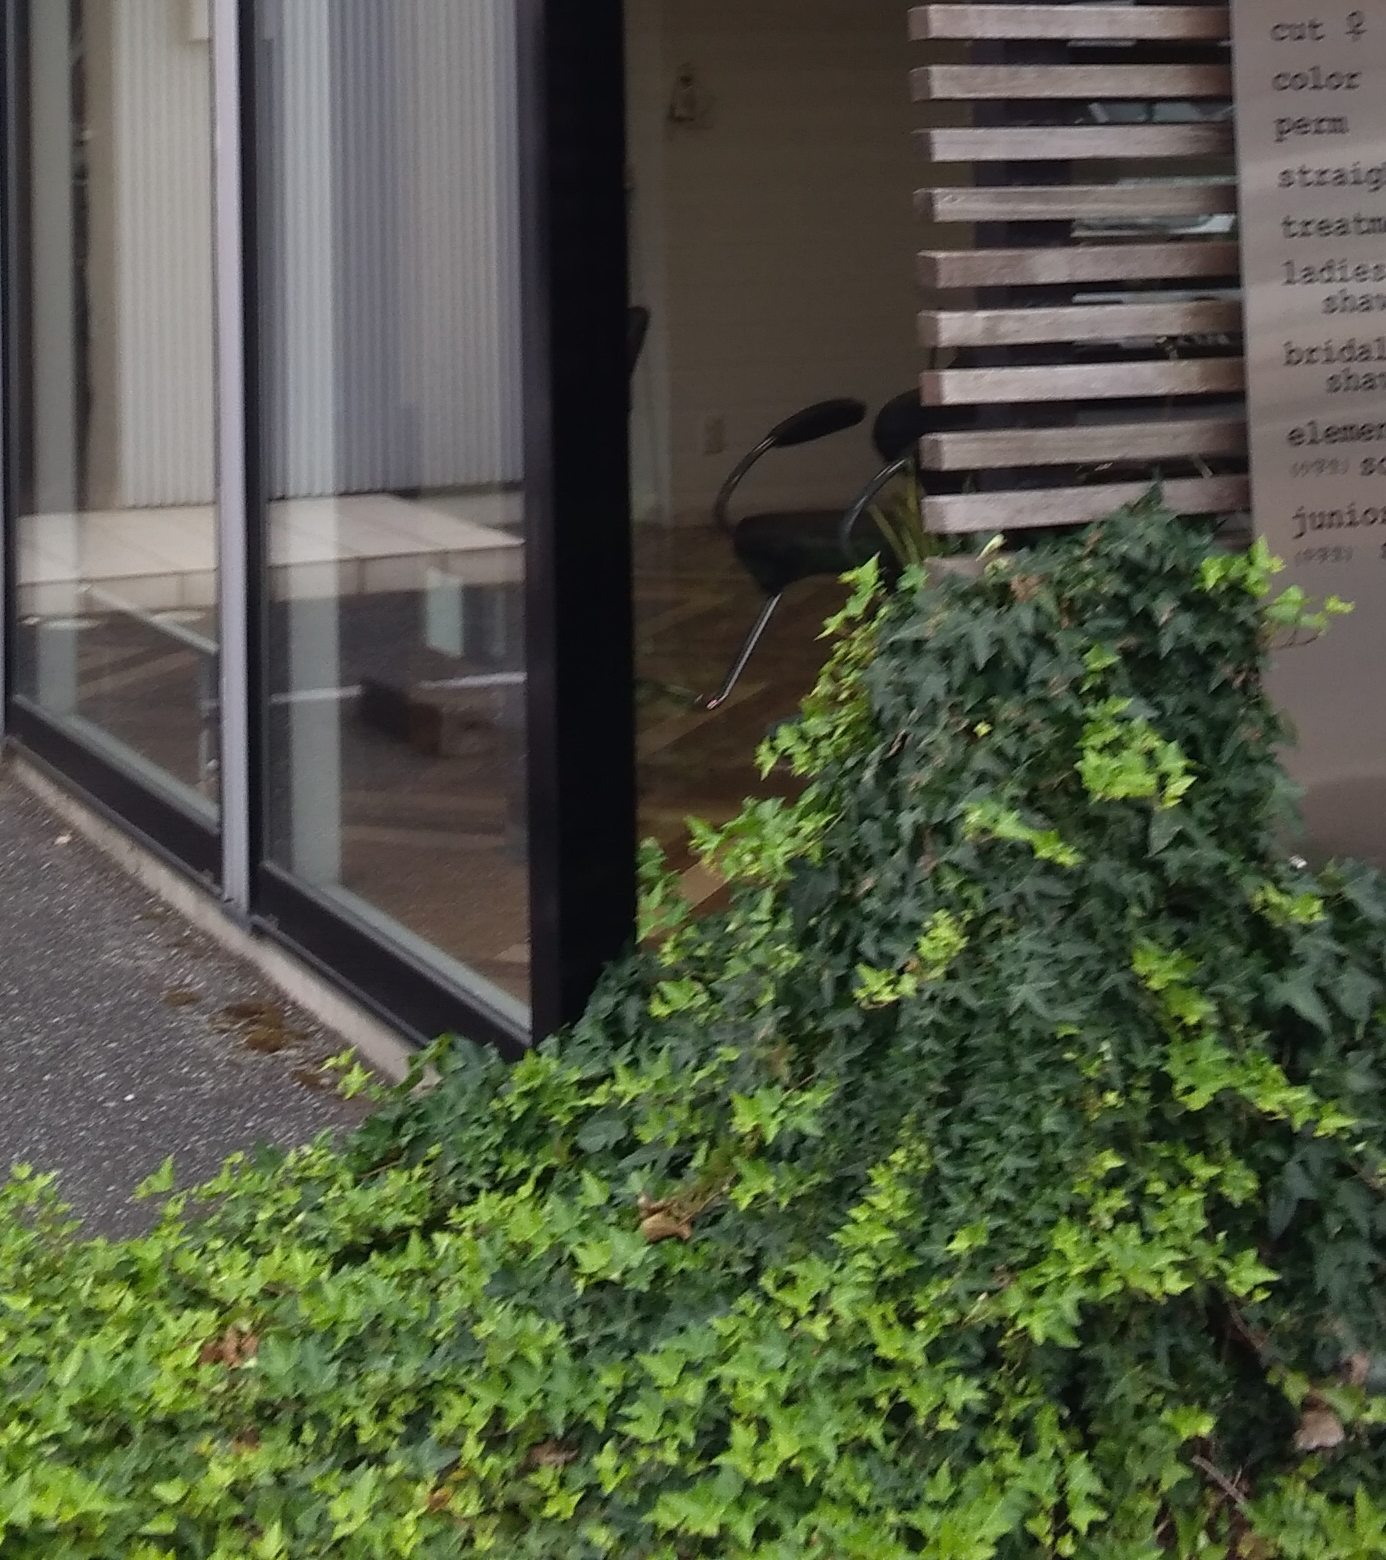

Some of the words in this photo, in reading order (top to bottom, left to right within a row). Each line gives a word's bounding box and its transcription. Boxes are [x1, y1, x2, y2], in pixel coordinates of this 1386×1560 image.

[1270, 18, 1326, 42] cut
[1271, 65, 1362, 92] color
[1273, 116, 1350, 143] perm
[1282, 258, 1386, 285] ladies
